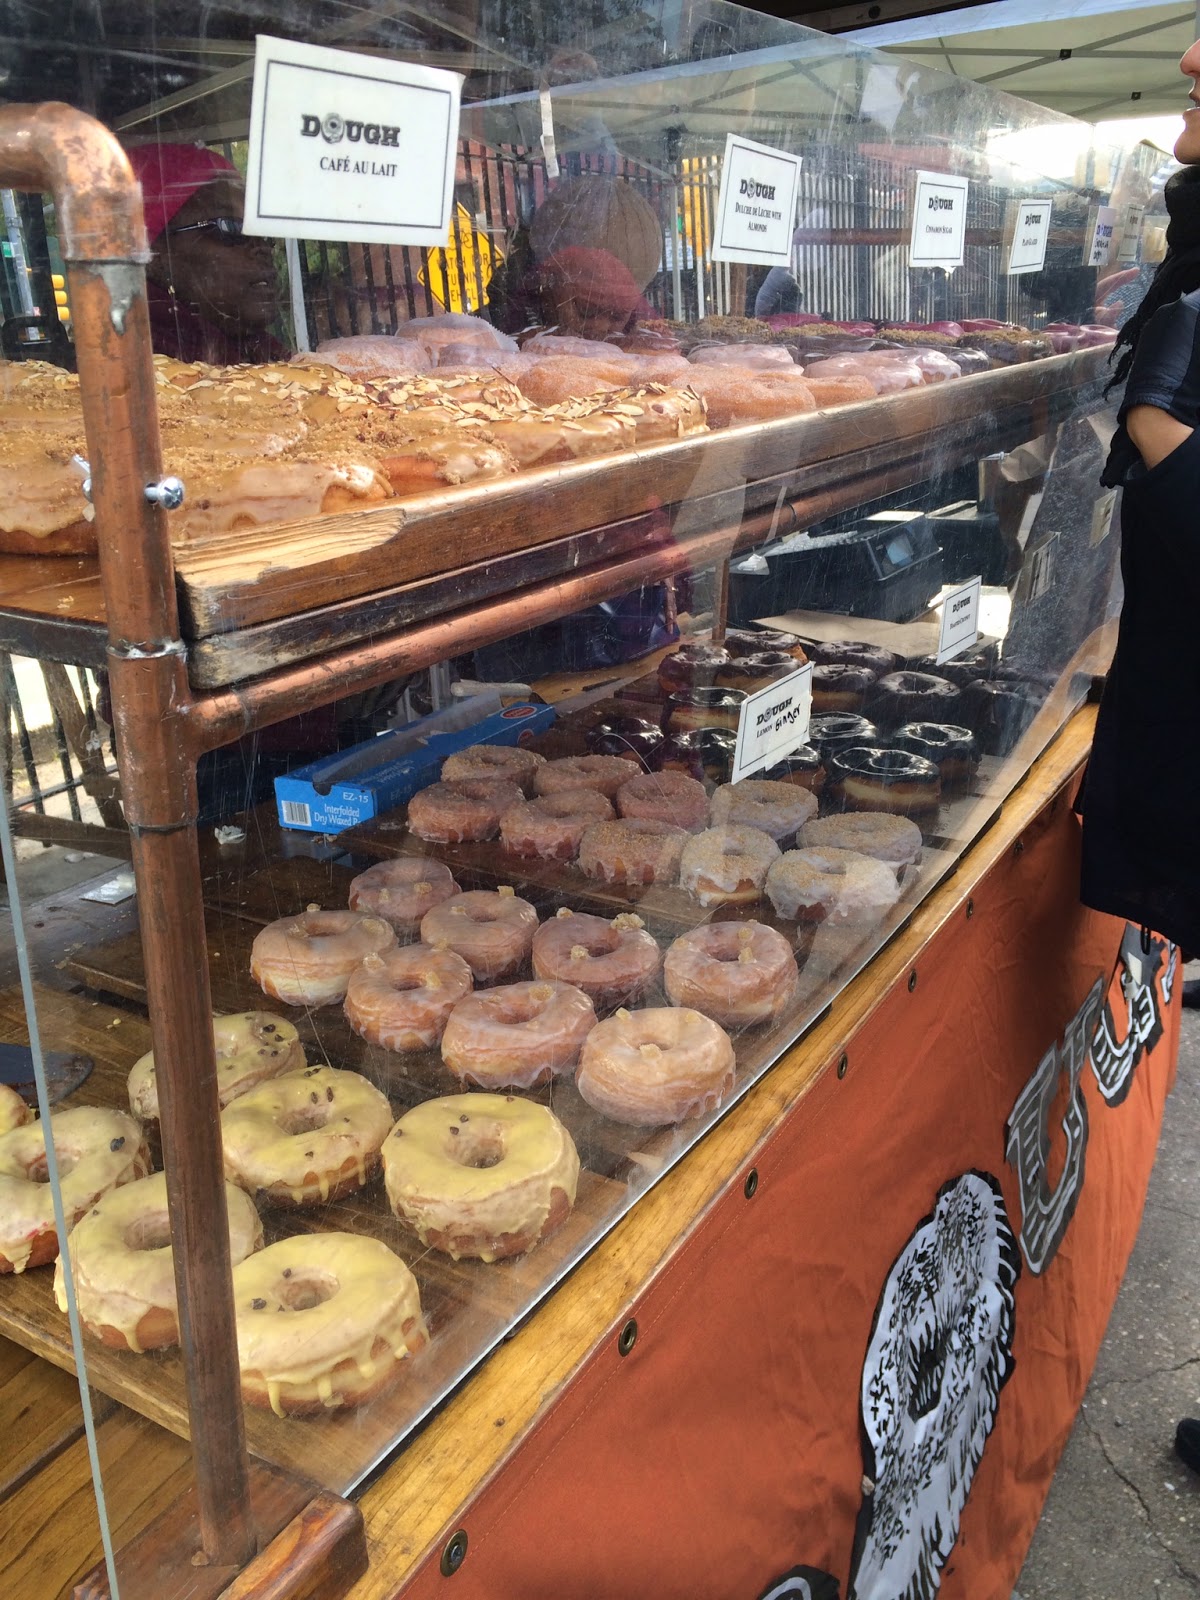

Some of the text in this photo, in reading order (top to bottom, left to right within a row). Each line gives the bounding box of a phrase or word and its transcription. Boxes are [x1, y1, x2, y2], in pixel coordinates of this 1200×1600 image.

[301, 112, 401, 147] DOUGH
[319, 155, 398, 177] CAFÉ AU LAIT
[739, 177, 776, 201] DOUGH
[928, 195, 954, 211] DOUGH
[756, 696, 793, 726] DOUGH
[342, 791, 369, 804] EZ-15
[314, 811, 328, 826] Dry
[328, 814, 352, 827] Waxed
[324, 803, 360, 818] Interfolded
